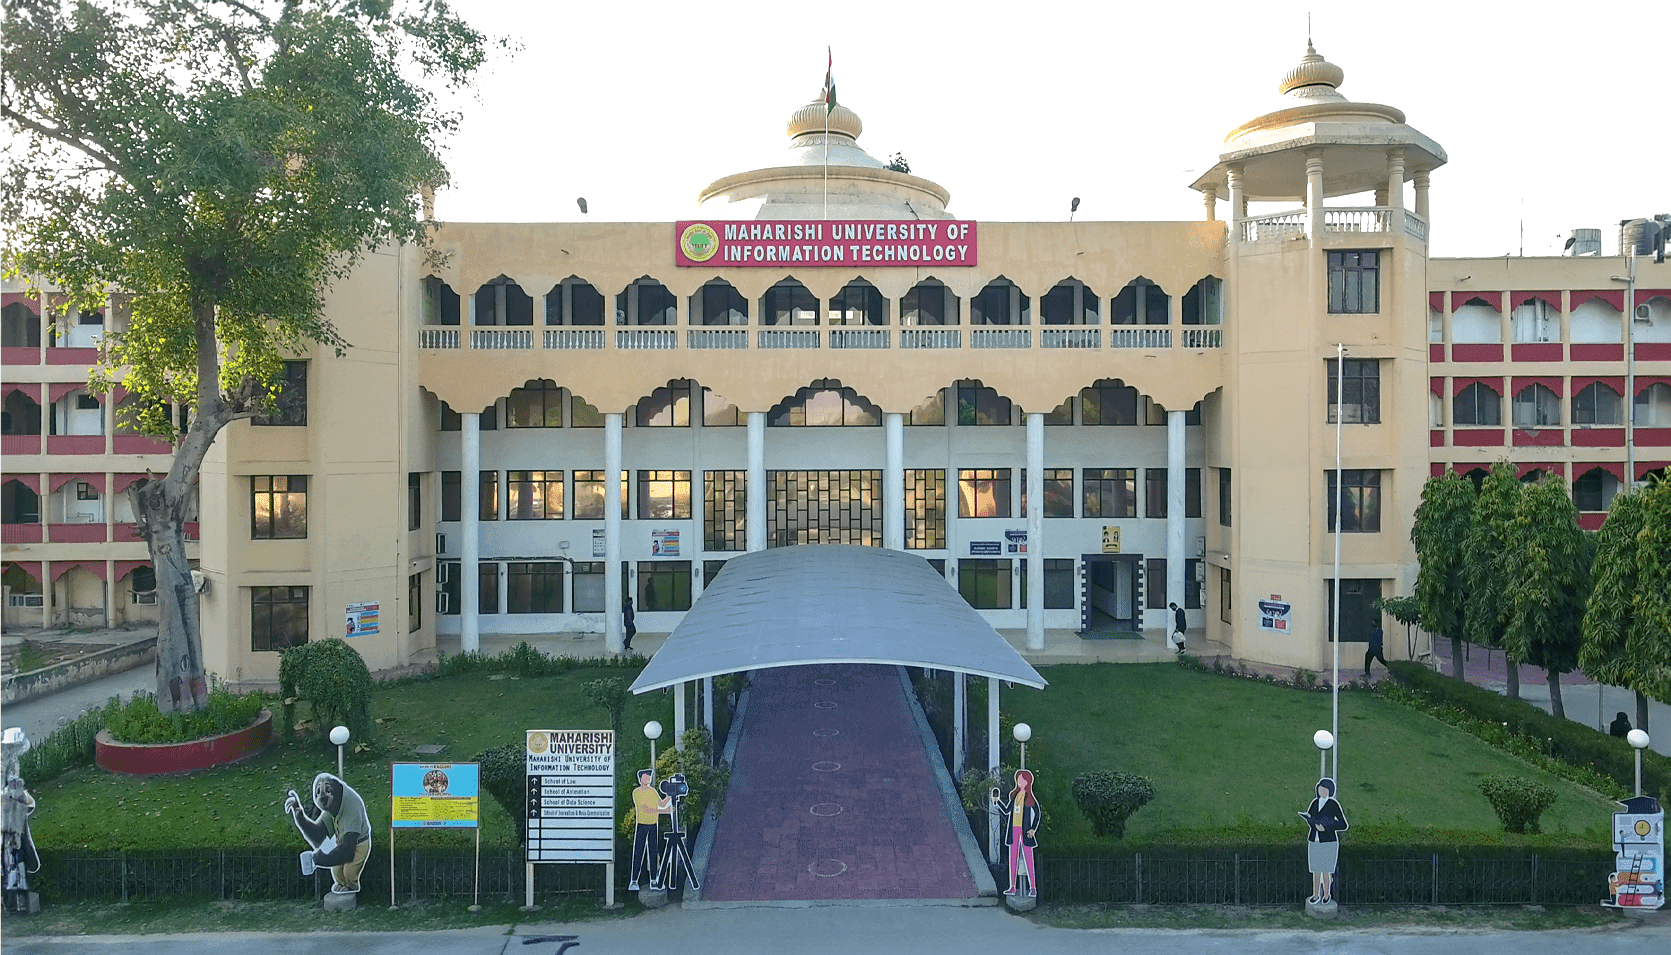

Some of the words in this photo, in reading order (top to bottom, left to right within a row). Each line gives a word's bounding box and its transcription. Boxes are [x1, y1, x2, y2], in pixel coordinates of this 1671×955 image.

[724, 224, 823, 240] MAHARISHI
[832, 224, 938, 240] UNIVERSITY
[947, 224, 969, 240] OF
[724, 245, 844, 261] INFORMATION
[850, 245, 968, 261] TECHNOLOGY
[550, 732, 612, 743] MAHARISHI
[550, 744, 612, 754] UNIVERSITY
